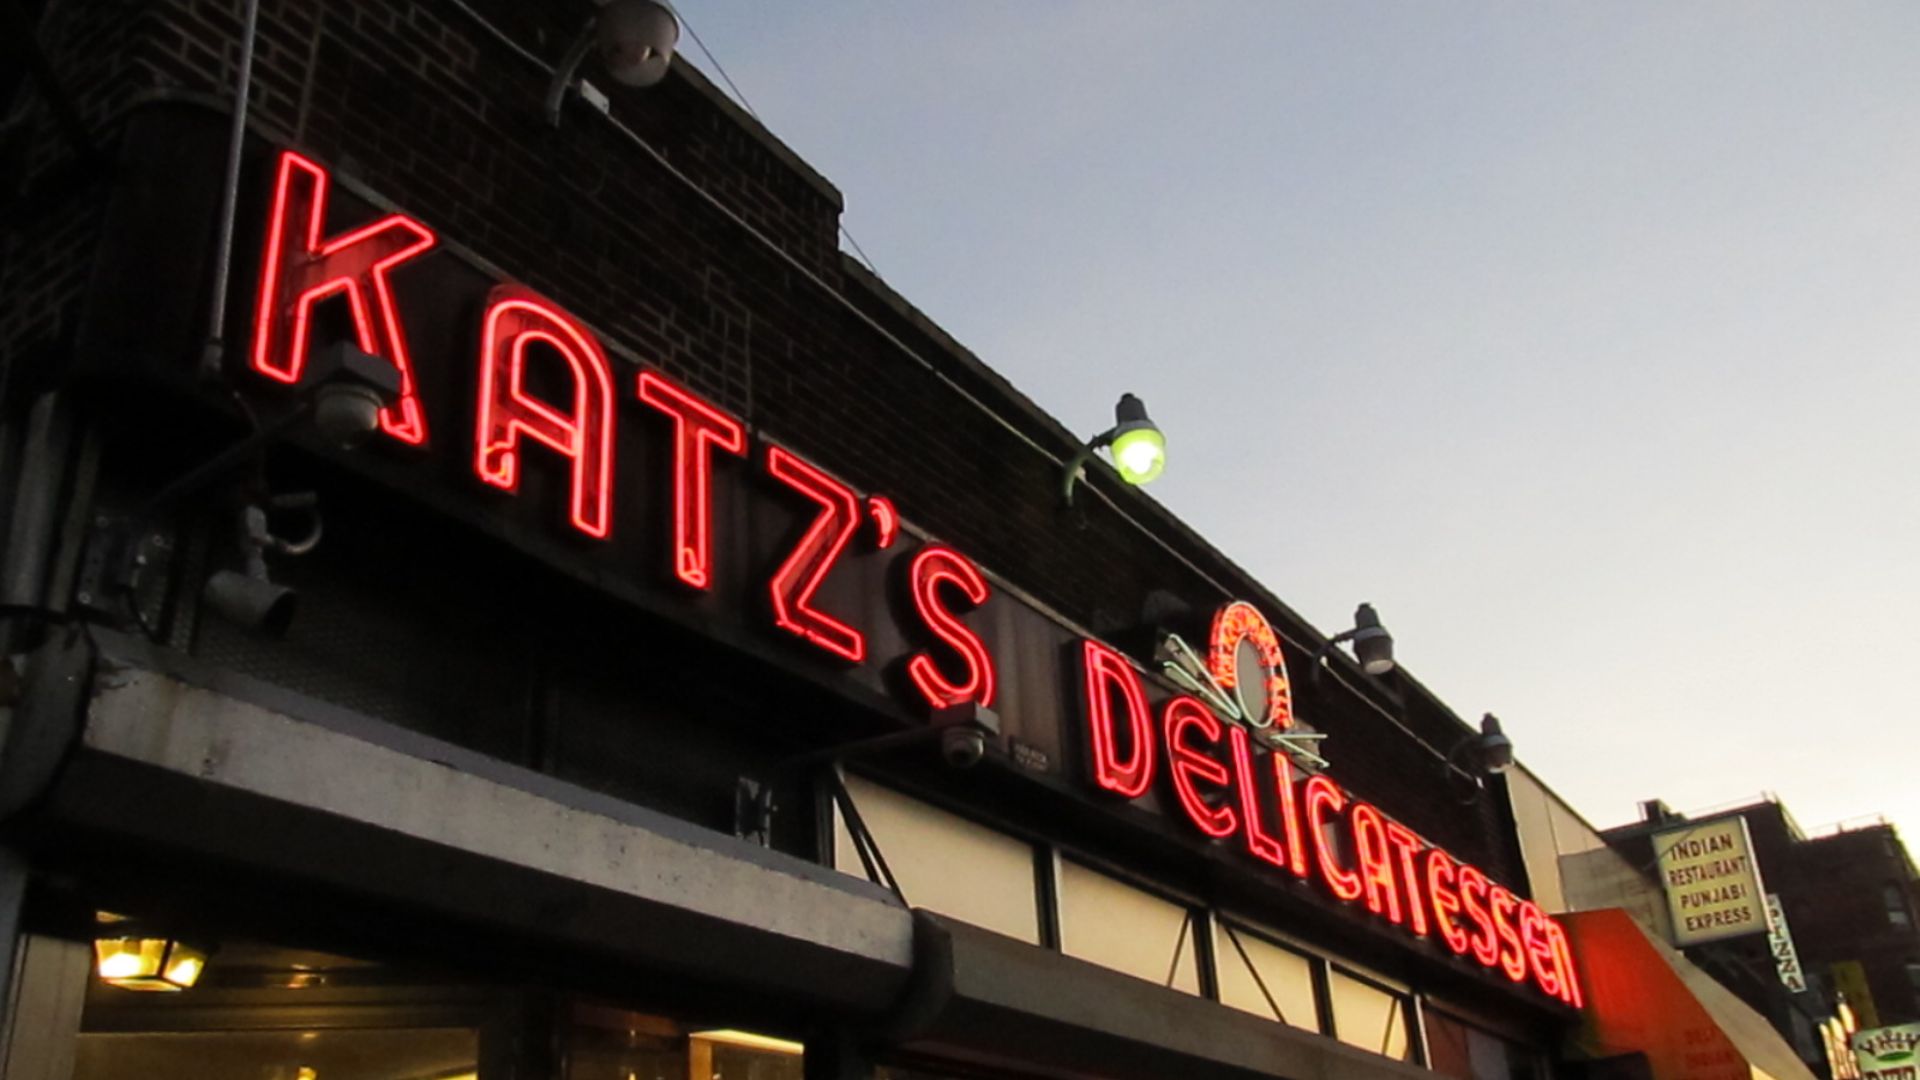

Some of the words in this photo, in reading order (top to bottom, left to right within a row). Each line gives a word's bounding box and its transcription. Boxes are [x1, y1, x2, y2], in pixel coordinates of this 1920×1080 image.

[250, 149, 995, 709] KATZ'S
[1670, 833, 1733, 861] INDIAN
[1668, 855, 1747, 887] RESTAURANT
[1680, 882, 1748, 909] PUNJABI
[1685, 906, 1752, 932] EXPRESS
